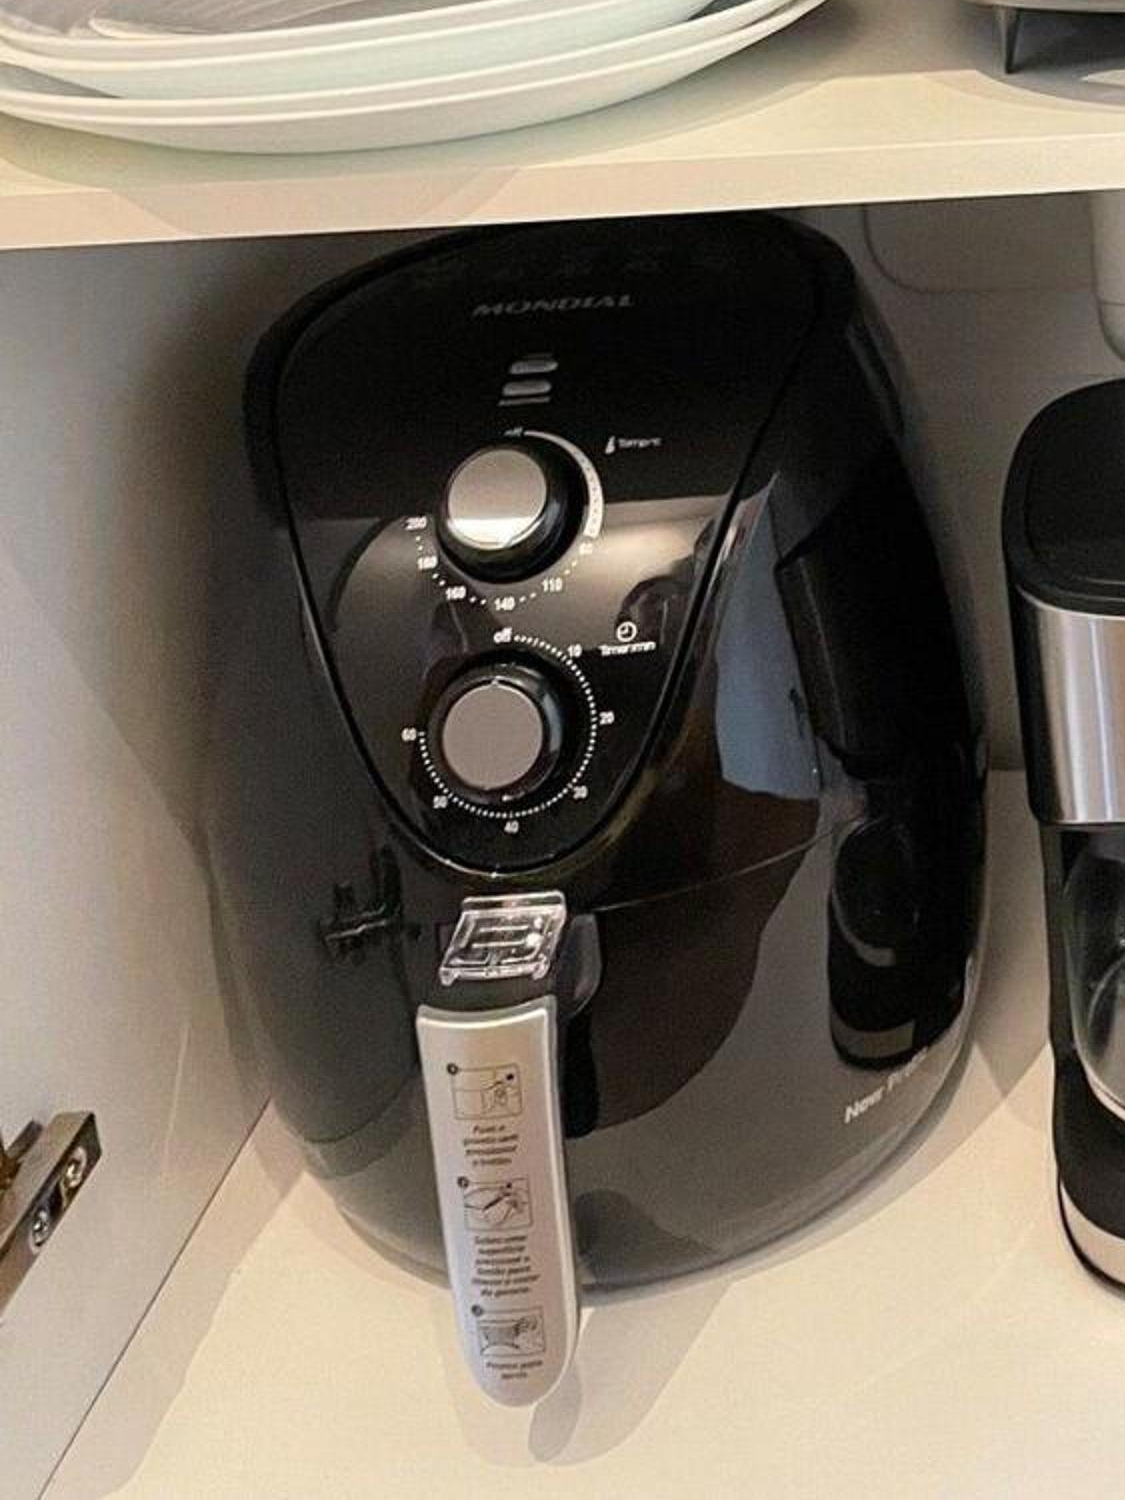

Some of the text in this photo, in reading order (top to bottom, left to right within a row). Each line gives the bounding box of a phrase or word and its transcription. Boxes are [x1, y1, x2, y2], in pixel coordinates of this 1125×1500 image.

[472, 294, 634, 317] MONDIAL
[494, 596, 516, 611] 140
[568, 644, 583, 658] 10
[599, 711, 615, 725] 20
[401, 728, 417, 742] 60
[504, 820, 519, 834] 40
